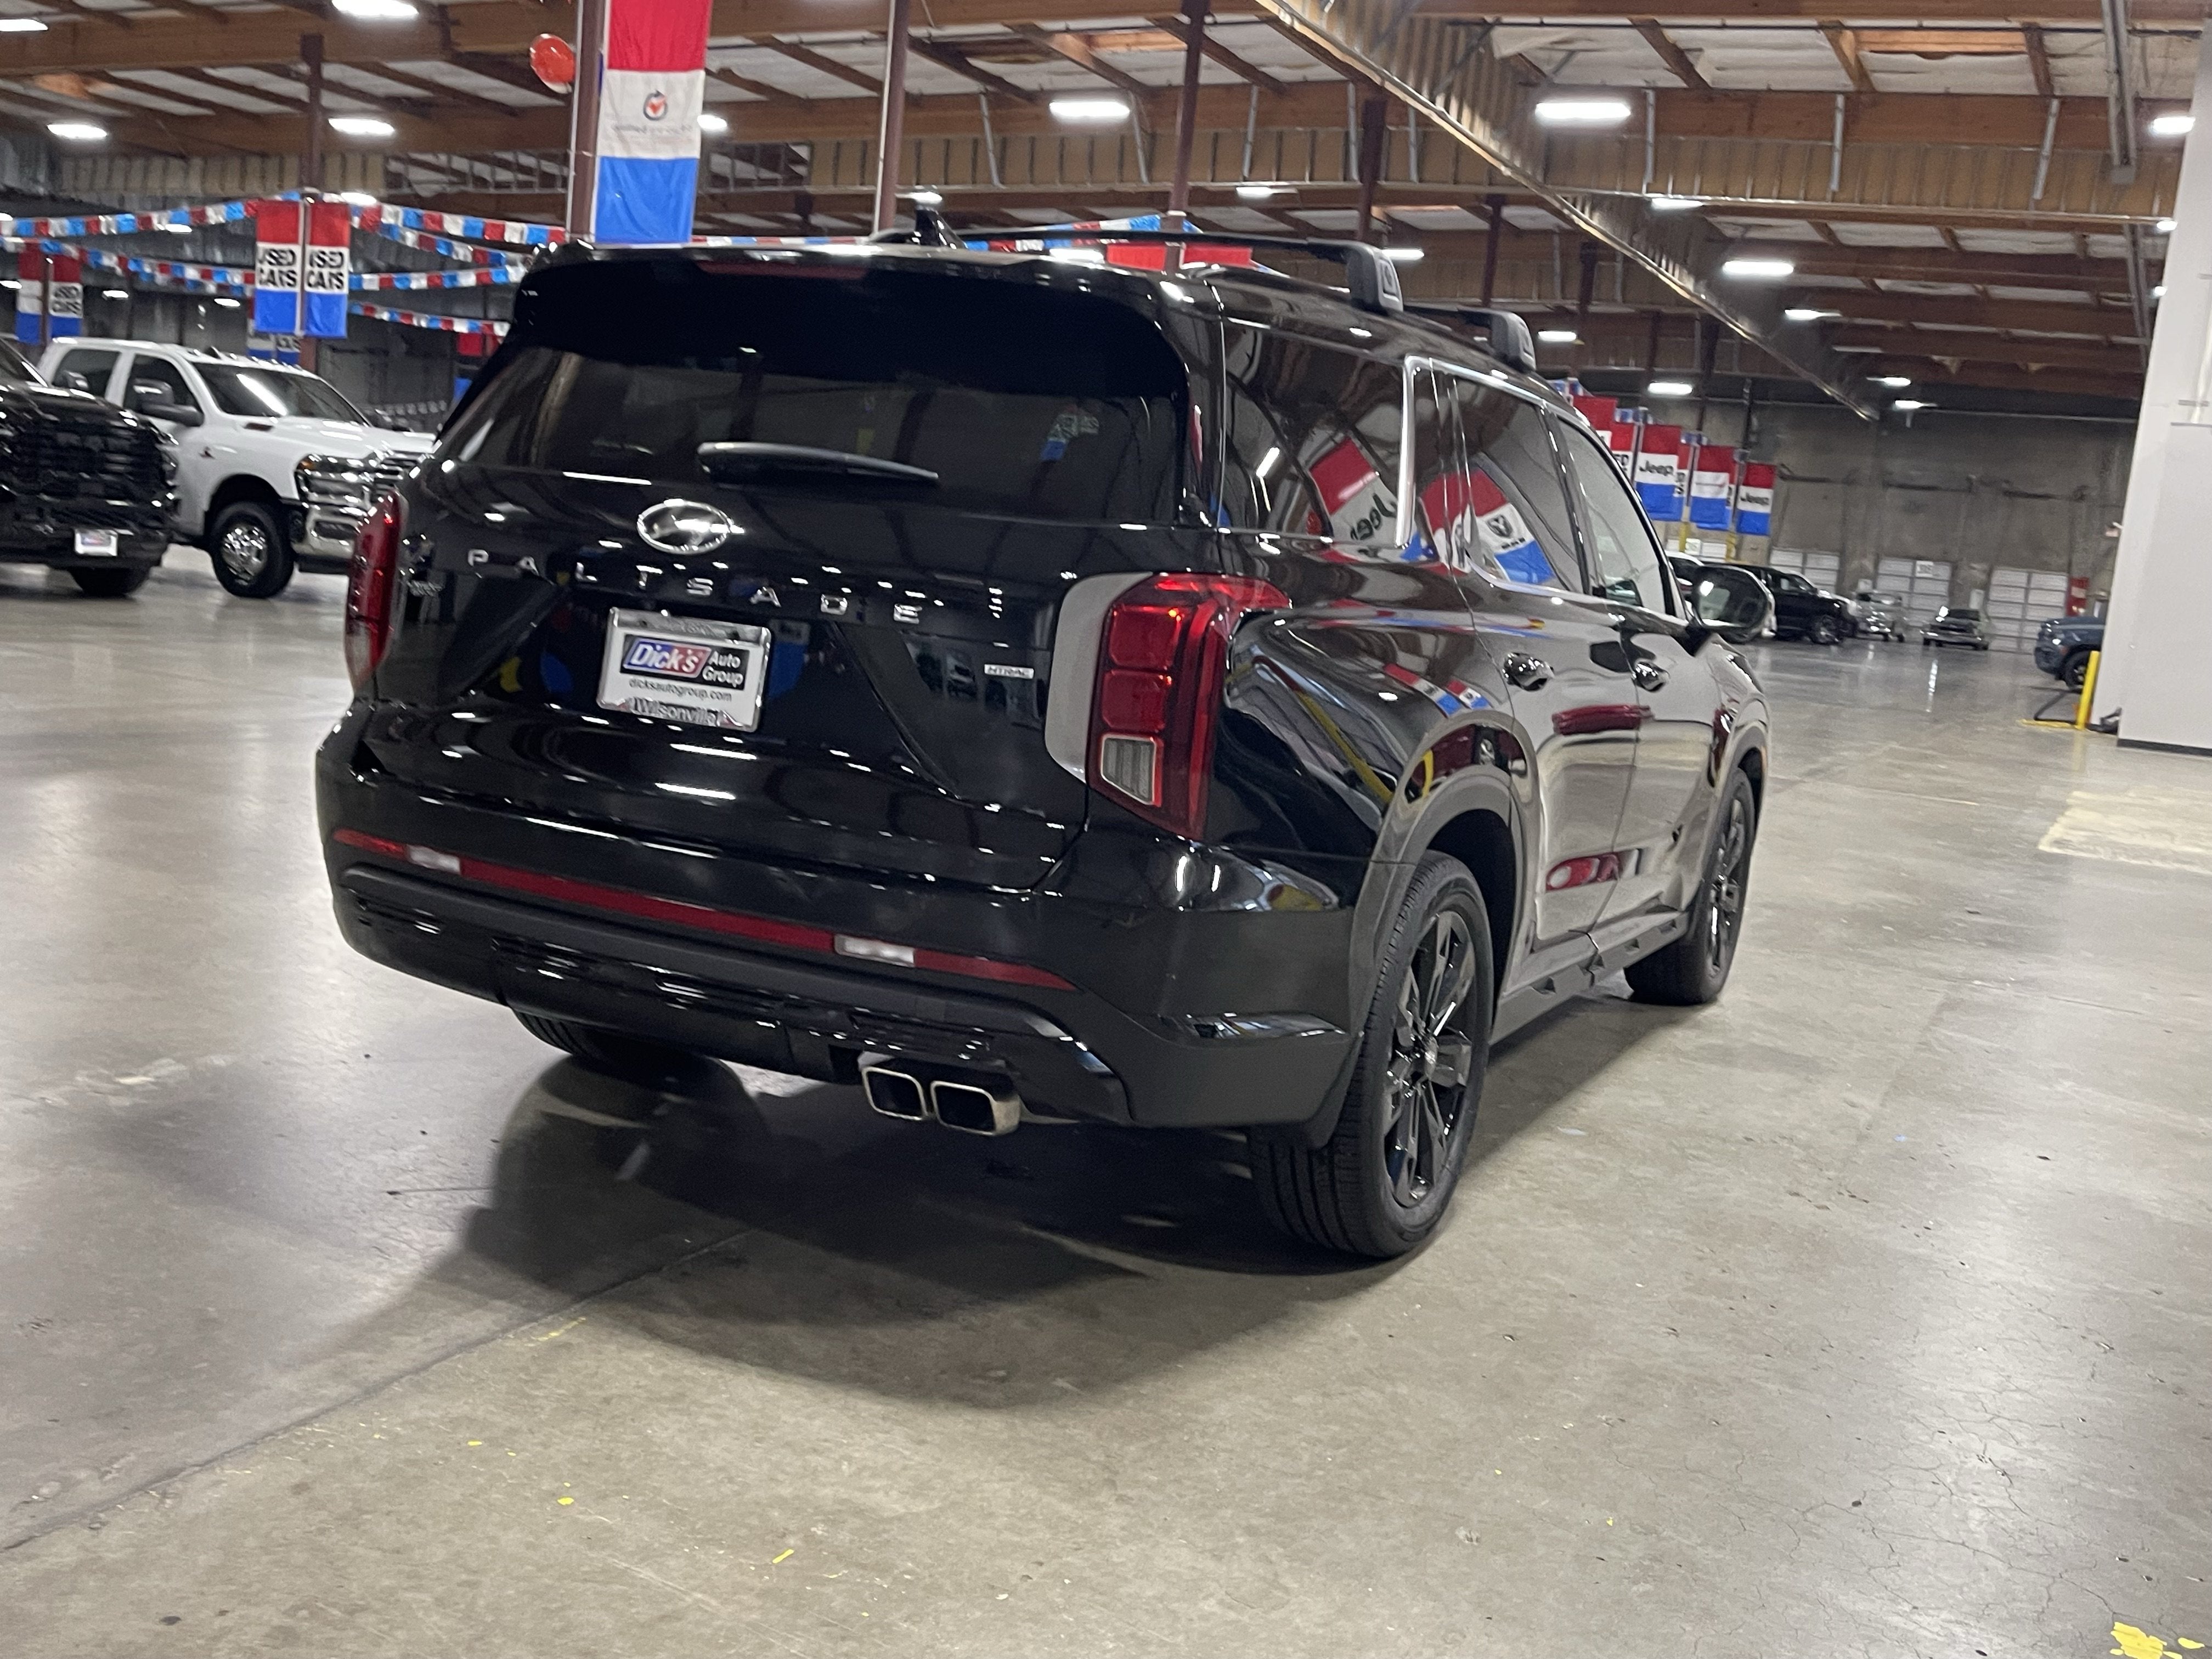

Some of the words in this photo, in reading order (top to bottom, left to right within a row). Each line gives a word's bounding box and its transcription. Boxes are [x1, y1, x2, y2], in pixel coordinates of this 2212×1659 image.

[1639, 459, 1674, 476] Jeep
[1740, 492, 1770, 506] Jeep
[467, 549, 922, 625] PALISADE
[630, 644, 699, 673] Dick's
[708, 650, 741, 668] Auto
[702, 665, 743, 688] Group
[629, 678, 732, 702] dicksautogroup.com
